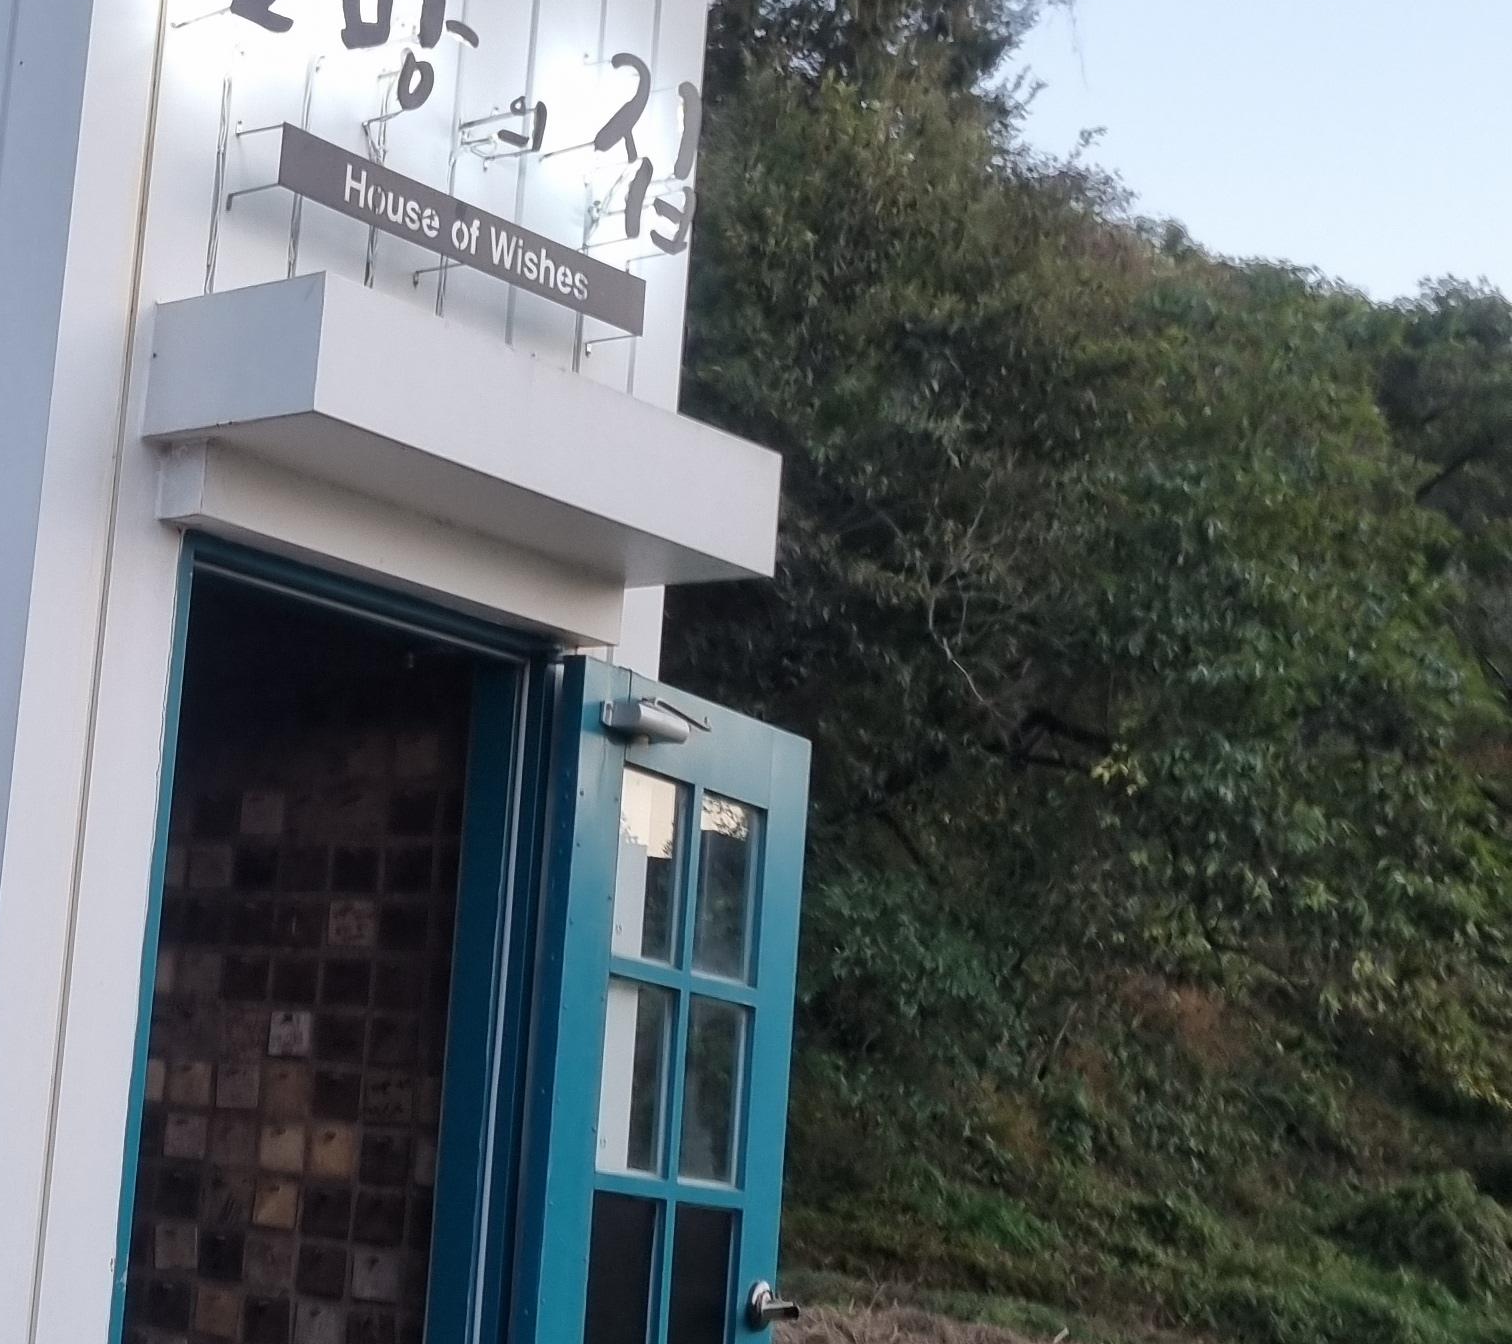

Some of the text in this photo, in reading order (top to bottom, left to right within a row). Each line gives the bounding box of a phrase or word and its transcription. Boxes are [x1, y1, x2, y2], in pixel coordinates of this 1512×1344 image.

[344, 163, 588, 301] House of Wishes
[594, 52, 703, 256] 집
